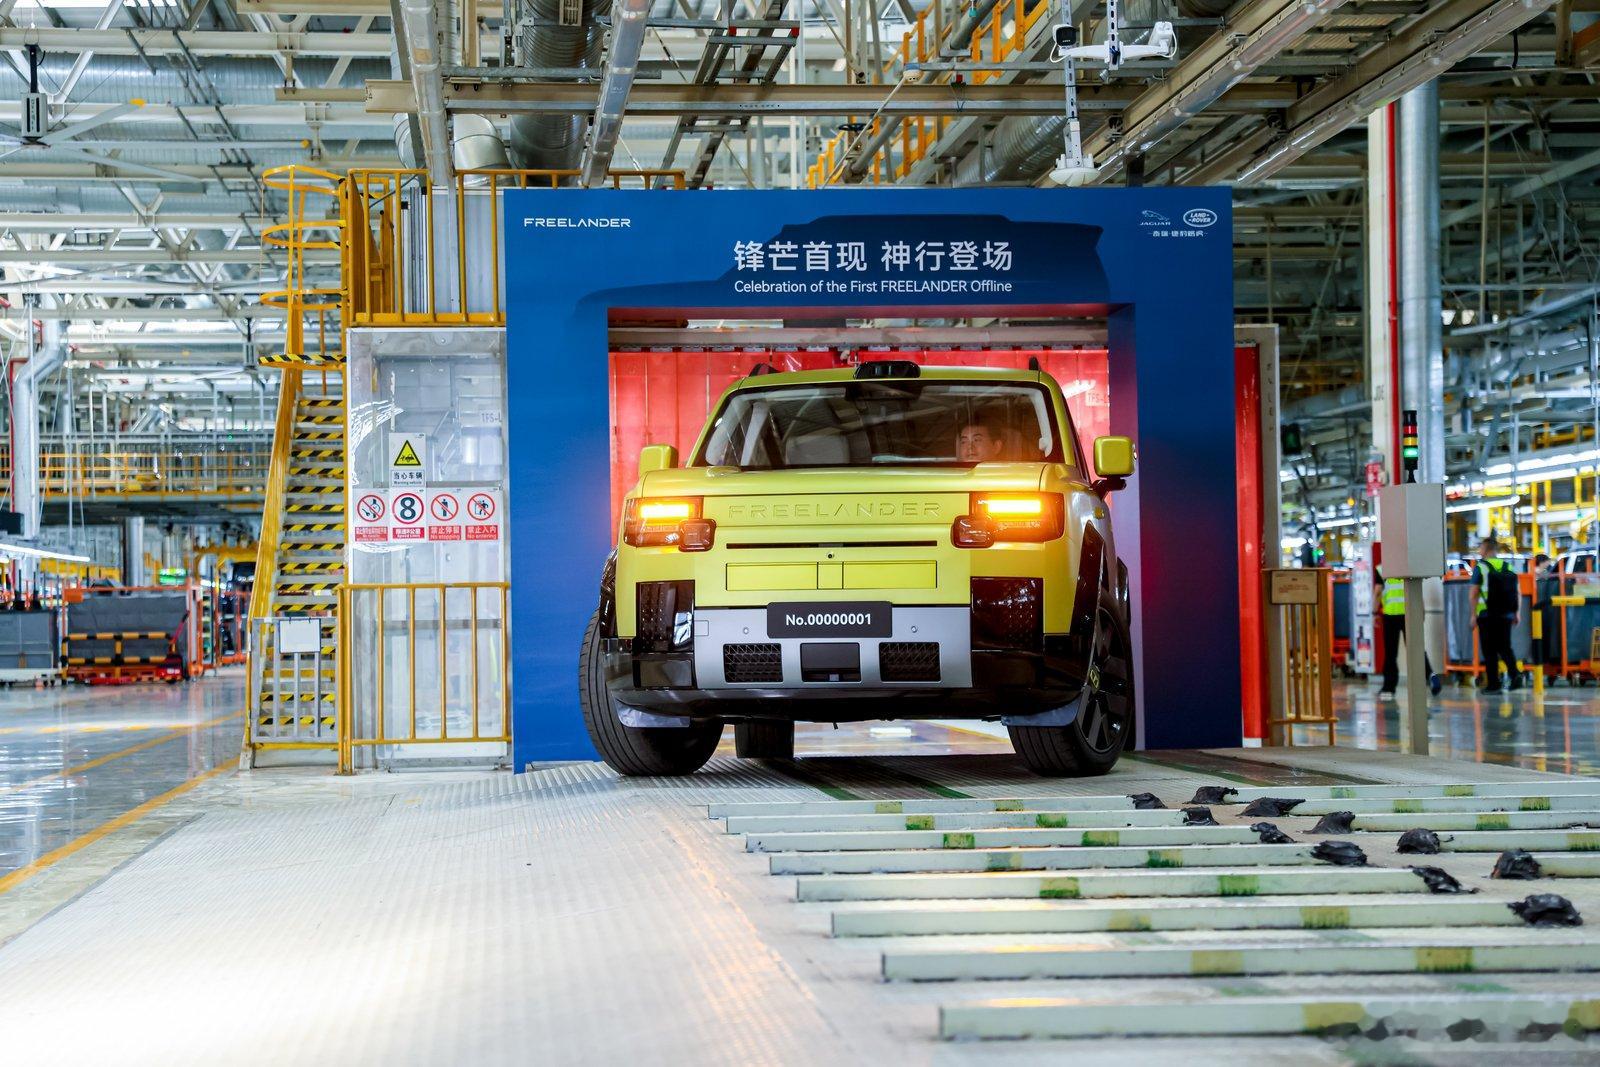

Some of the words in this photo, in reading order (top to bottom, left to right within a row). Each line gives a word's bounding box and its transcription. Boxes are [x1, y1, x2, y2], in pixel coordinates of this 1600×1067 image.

[523, 217, 632, 228] FREELANDER
[733, 240, 868, 272] 锋芒首现
[880, 240, 1013, 272] 神行登场
[734, 280, 807, 293] Celebration
[810, 280, 824, 293] of
[826, 280, 847, 293] the
[850, 280, 878, 293] First
[881, 280, 968, 293] FREELANDER
[970, 280, 1013, 293] Offline
[400, 496, 416, 520] 8
[728, 502, 942, 519] FREELANDER
[785, 613, 871, 626] No.00000001
